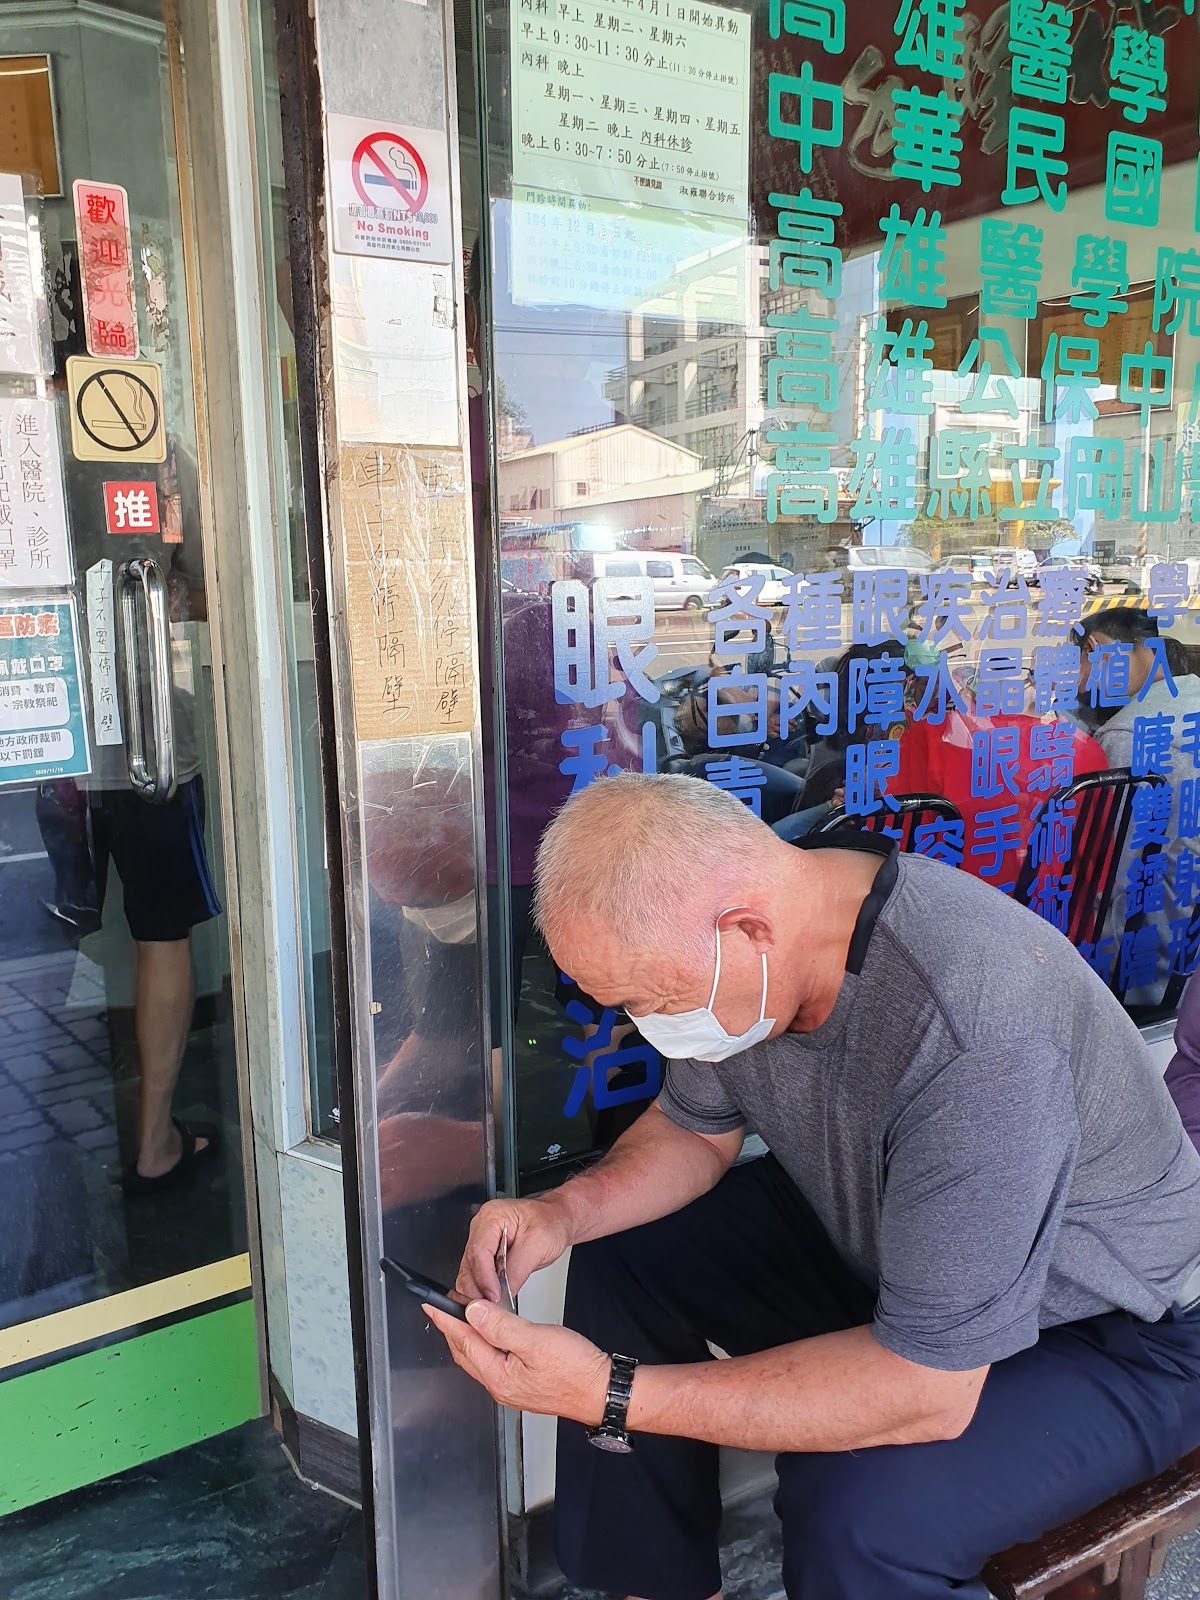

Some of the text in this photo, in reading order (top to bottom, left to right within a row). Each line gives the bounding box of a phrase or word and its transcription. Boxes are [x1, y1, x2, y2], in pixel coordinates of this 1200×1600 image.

[557, 59, 584, 77] 晚上
[558, 3, 584, 23] 早上
[594, 13, 687, 48] 星期二、星期六
[558, 113, 599, 131] 星期二
[607, 123, 633, 139] 晚上
[769, 61, 1163, 228] 中華民國
[86, 193, 127, 350] 歡迎光臨
[357, 220, 429, 240] No Smoking
[768, 188, 1200, 337] 高雄醫學院
[767, 308, 1200, 428] 高雄公保中
[16, 413, 51, 569] 進入醫院、診所
[113, 489, 153, 528] 推
[766, 422, 1200, 524] 高雄縣立岡山
[707, 567, 1087, 657] 各種眼疾治療
[861, 799, 1077, 877] 容手術
